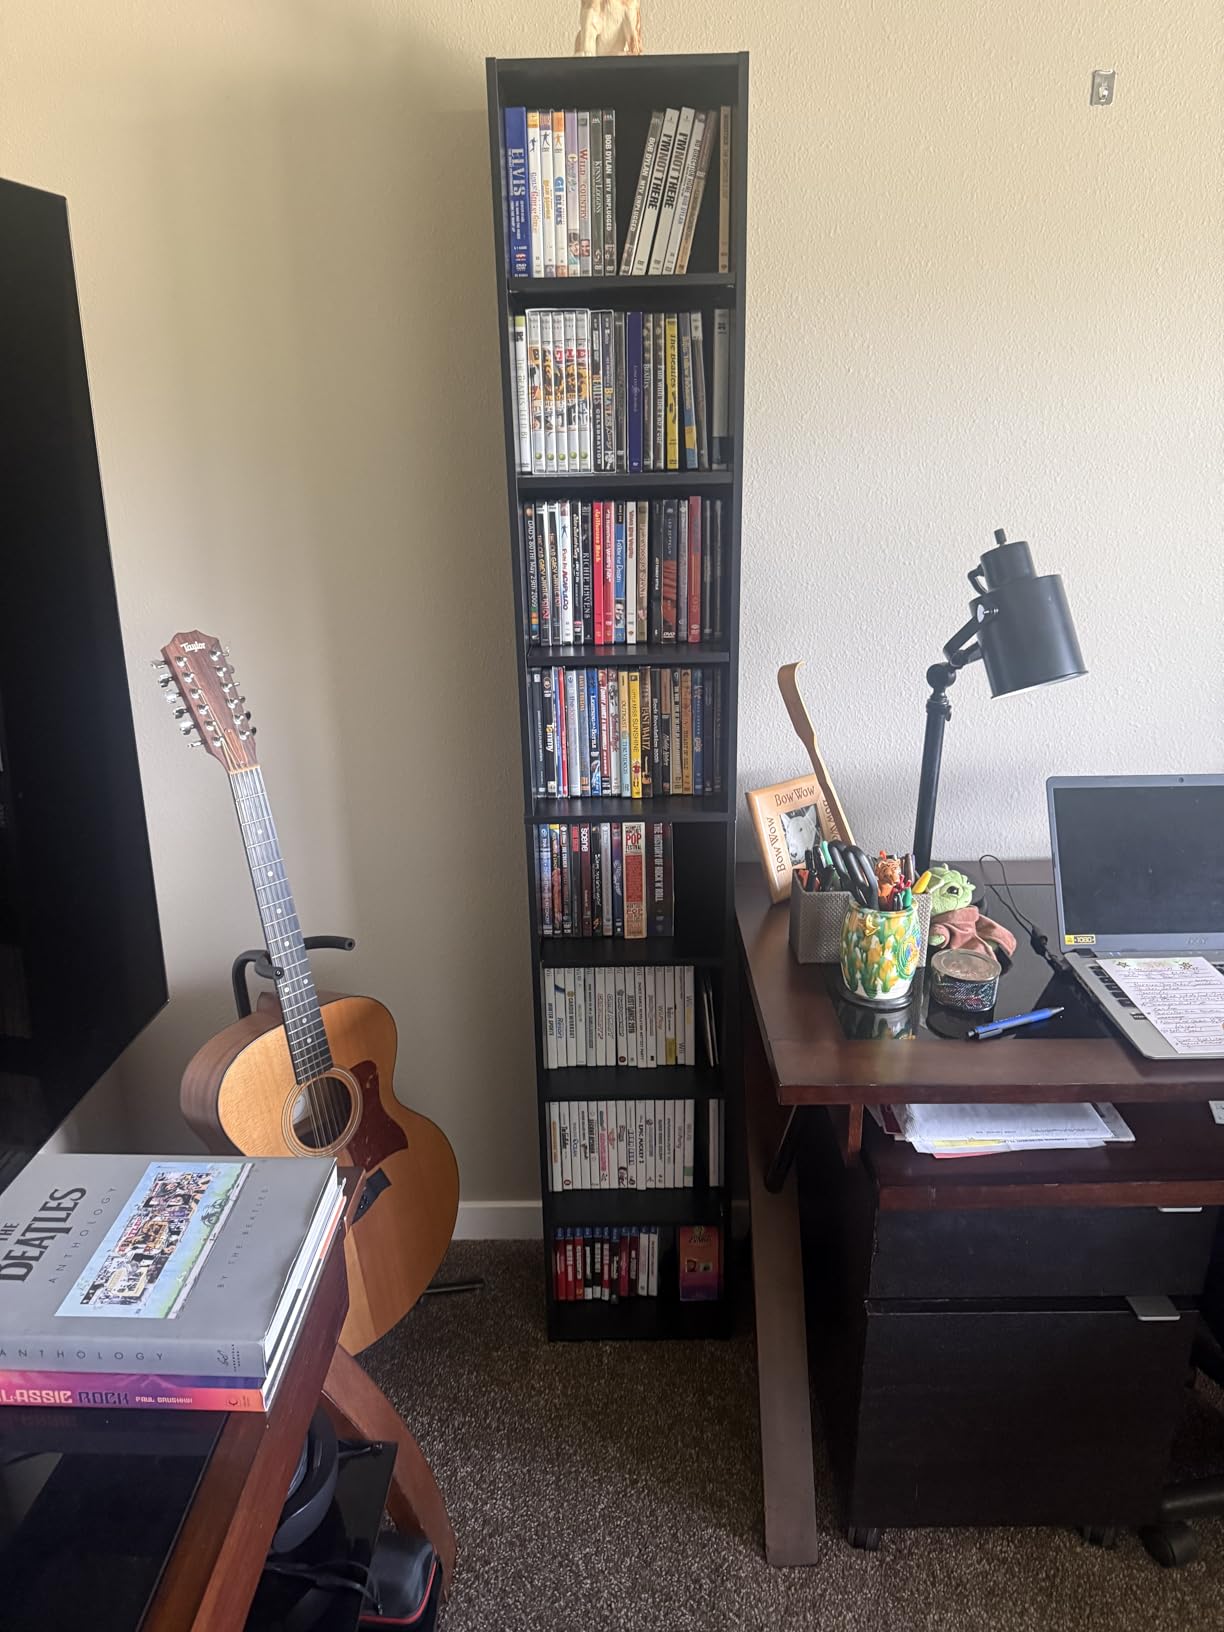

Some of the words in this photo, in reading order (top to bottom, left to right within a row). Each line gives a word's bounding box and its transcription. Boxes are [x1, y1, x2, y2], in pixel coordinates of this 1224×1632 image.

[646, 137, 656, 153] BOB
[659, 133, 673, 152] I'M
[676, 132, 689, 151] I'M
[579, 149, 587, 175] WILD
[641, 154, 652, 176] DYLAN
[654, 152, 669, 177] NOT
[671, 151, 685, 174] NOT
[688, 148, 700, 177] DIRECTION
[512, 149, 525, 196] ELVIS
[554, 176, 564, 192] GI
[638, 180, 646, 194] MTV
[648, 176, 664, 210] THERE
[664, 175, 680, 209] THERE
[684, 178, 694, 193] HOME
[556, 195, 564, 225] BLUES
[630, 195, 643, 232] UNPLUGGED
[678, 206, 688, 224] DYLAN
[592, 374, 602, 404] BEATLES
[604, 387, 614, 427] BEATLES
[521, 431, 528, 440] BE
[527, 520, 535, 540] DAD'S
[616, 539, 624, 556] Follow
[562, 562, 567, 570] IN
[616, 565, 624, 583] Dream
[639, 572, 647, 598] STAR
[180, 641, 206, 652] Taylor
[642, 707, 650, 726] LAST
[545, 723, 554, 752] Tommy
[642, 726, 650, 751] WALTZ
[654, 823, 662, 834] THE
[626, 833, 642, 845] POP
[654, 834, 663, 858] HISTORY
[655, 866, 663, 881] ROCK
[655, 888, 663, 902] ROLL
[627, 995, 635, 1005] JUST
[0, 1187, 87, 1282] BEATLES
[48, 1188, 117, 1284] ANTHOLOGY
[0, 1350, 164, 1361] ANTHOLOGY
[0, 1390, 73, 1404] LASSIC
[78, 1391, 129, 1406] ROCK
[135, 1395, 156, 1403] PAUL
